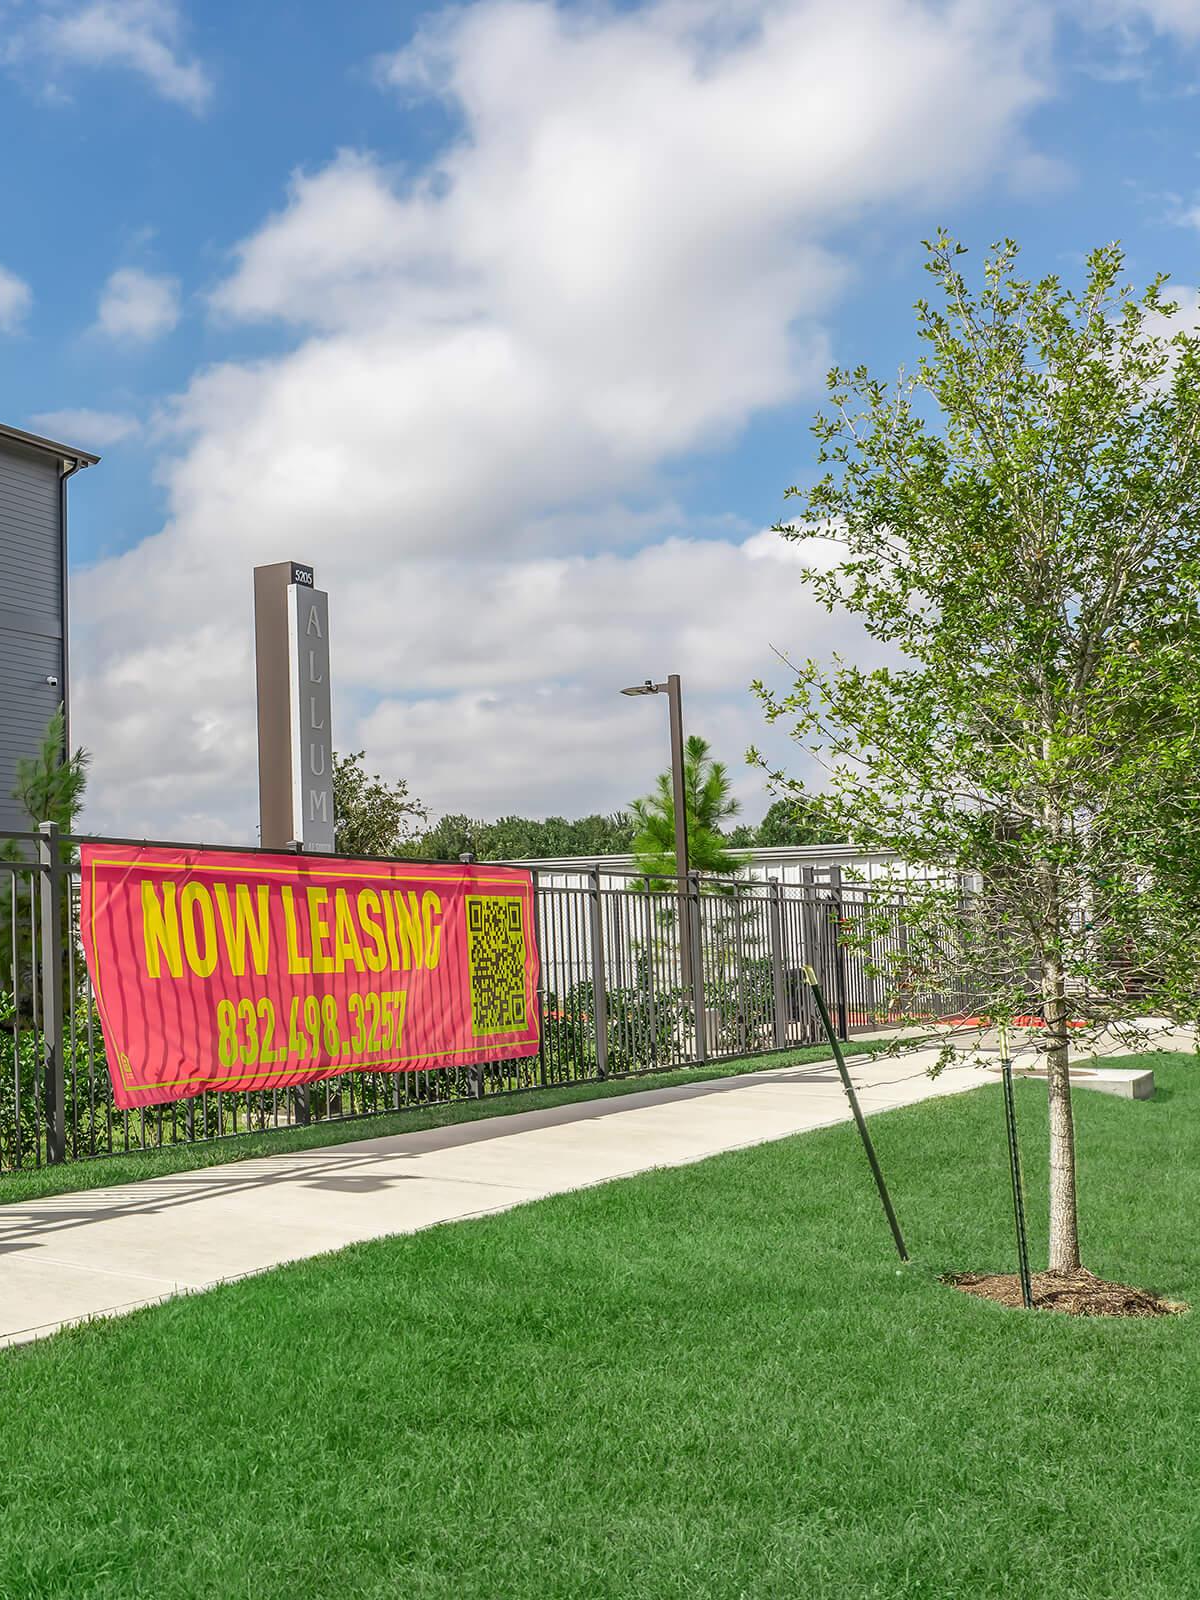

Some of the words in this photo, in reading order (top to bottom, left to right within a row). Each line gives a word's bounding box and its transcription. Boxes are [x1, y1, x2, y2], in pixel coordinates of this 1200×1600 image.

[295, 569, 312, 584] 5205
[306, 605, 327, 823] ALLUM
[141, 880, 270, 978] NOW
[281, 885, 442, 975] LEASING
[217, 990, 407, 1067] 832.498.3257
